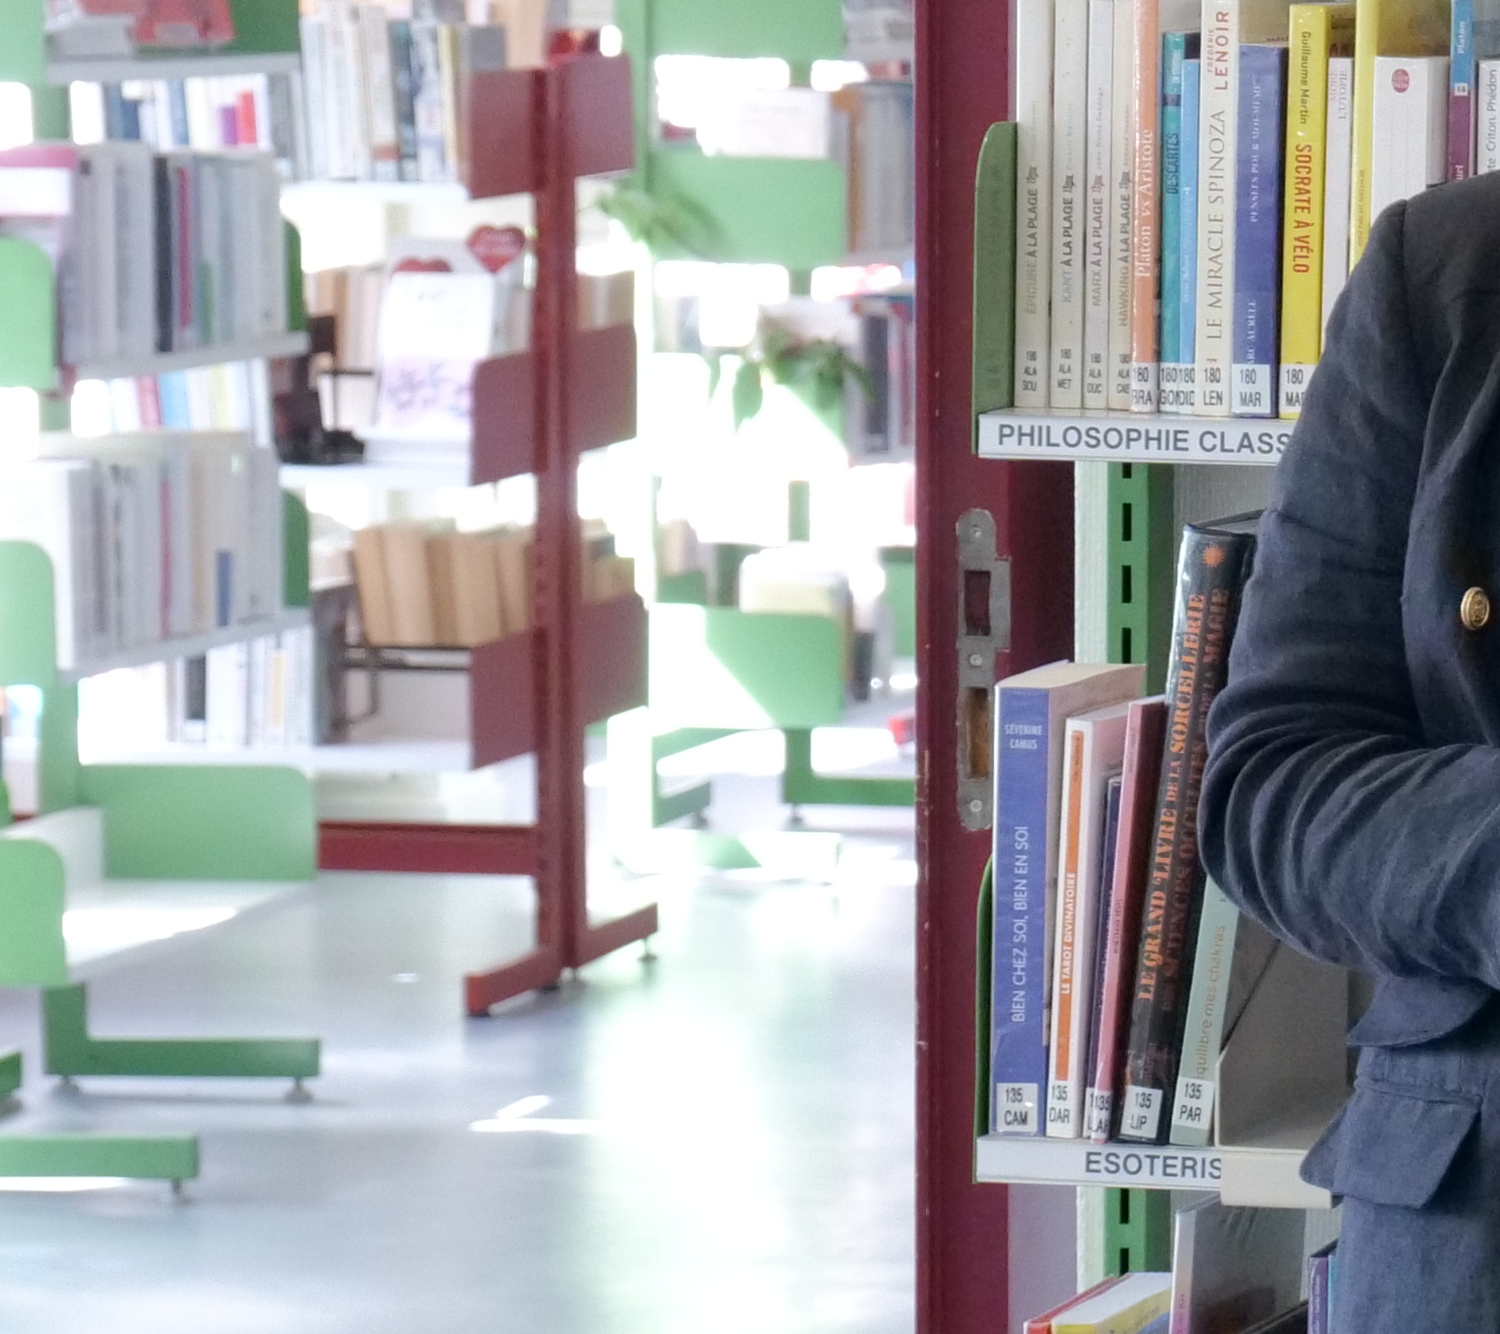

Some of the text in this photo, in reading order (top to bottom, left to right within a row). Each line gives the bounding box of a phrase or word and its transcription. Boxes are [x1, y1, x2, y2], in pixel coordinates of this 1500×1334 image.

[1295, 144, 1313, 213] SOCRATE
[1206, 109, 1226, 341] LE MIRACLE SPINOZA
[1291, 237, 1311, 274] VÉLO
[998, 424, 1190, 452] PHILOSOPHIE
